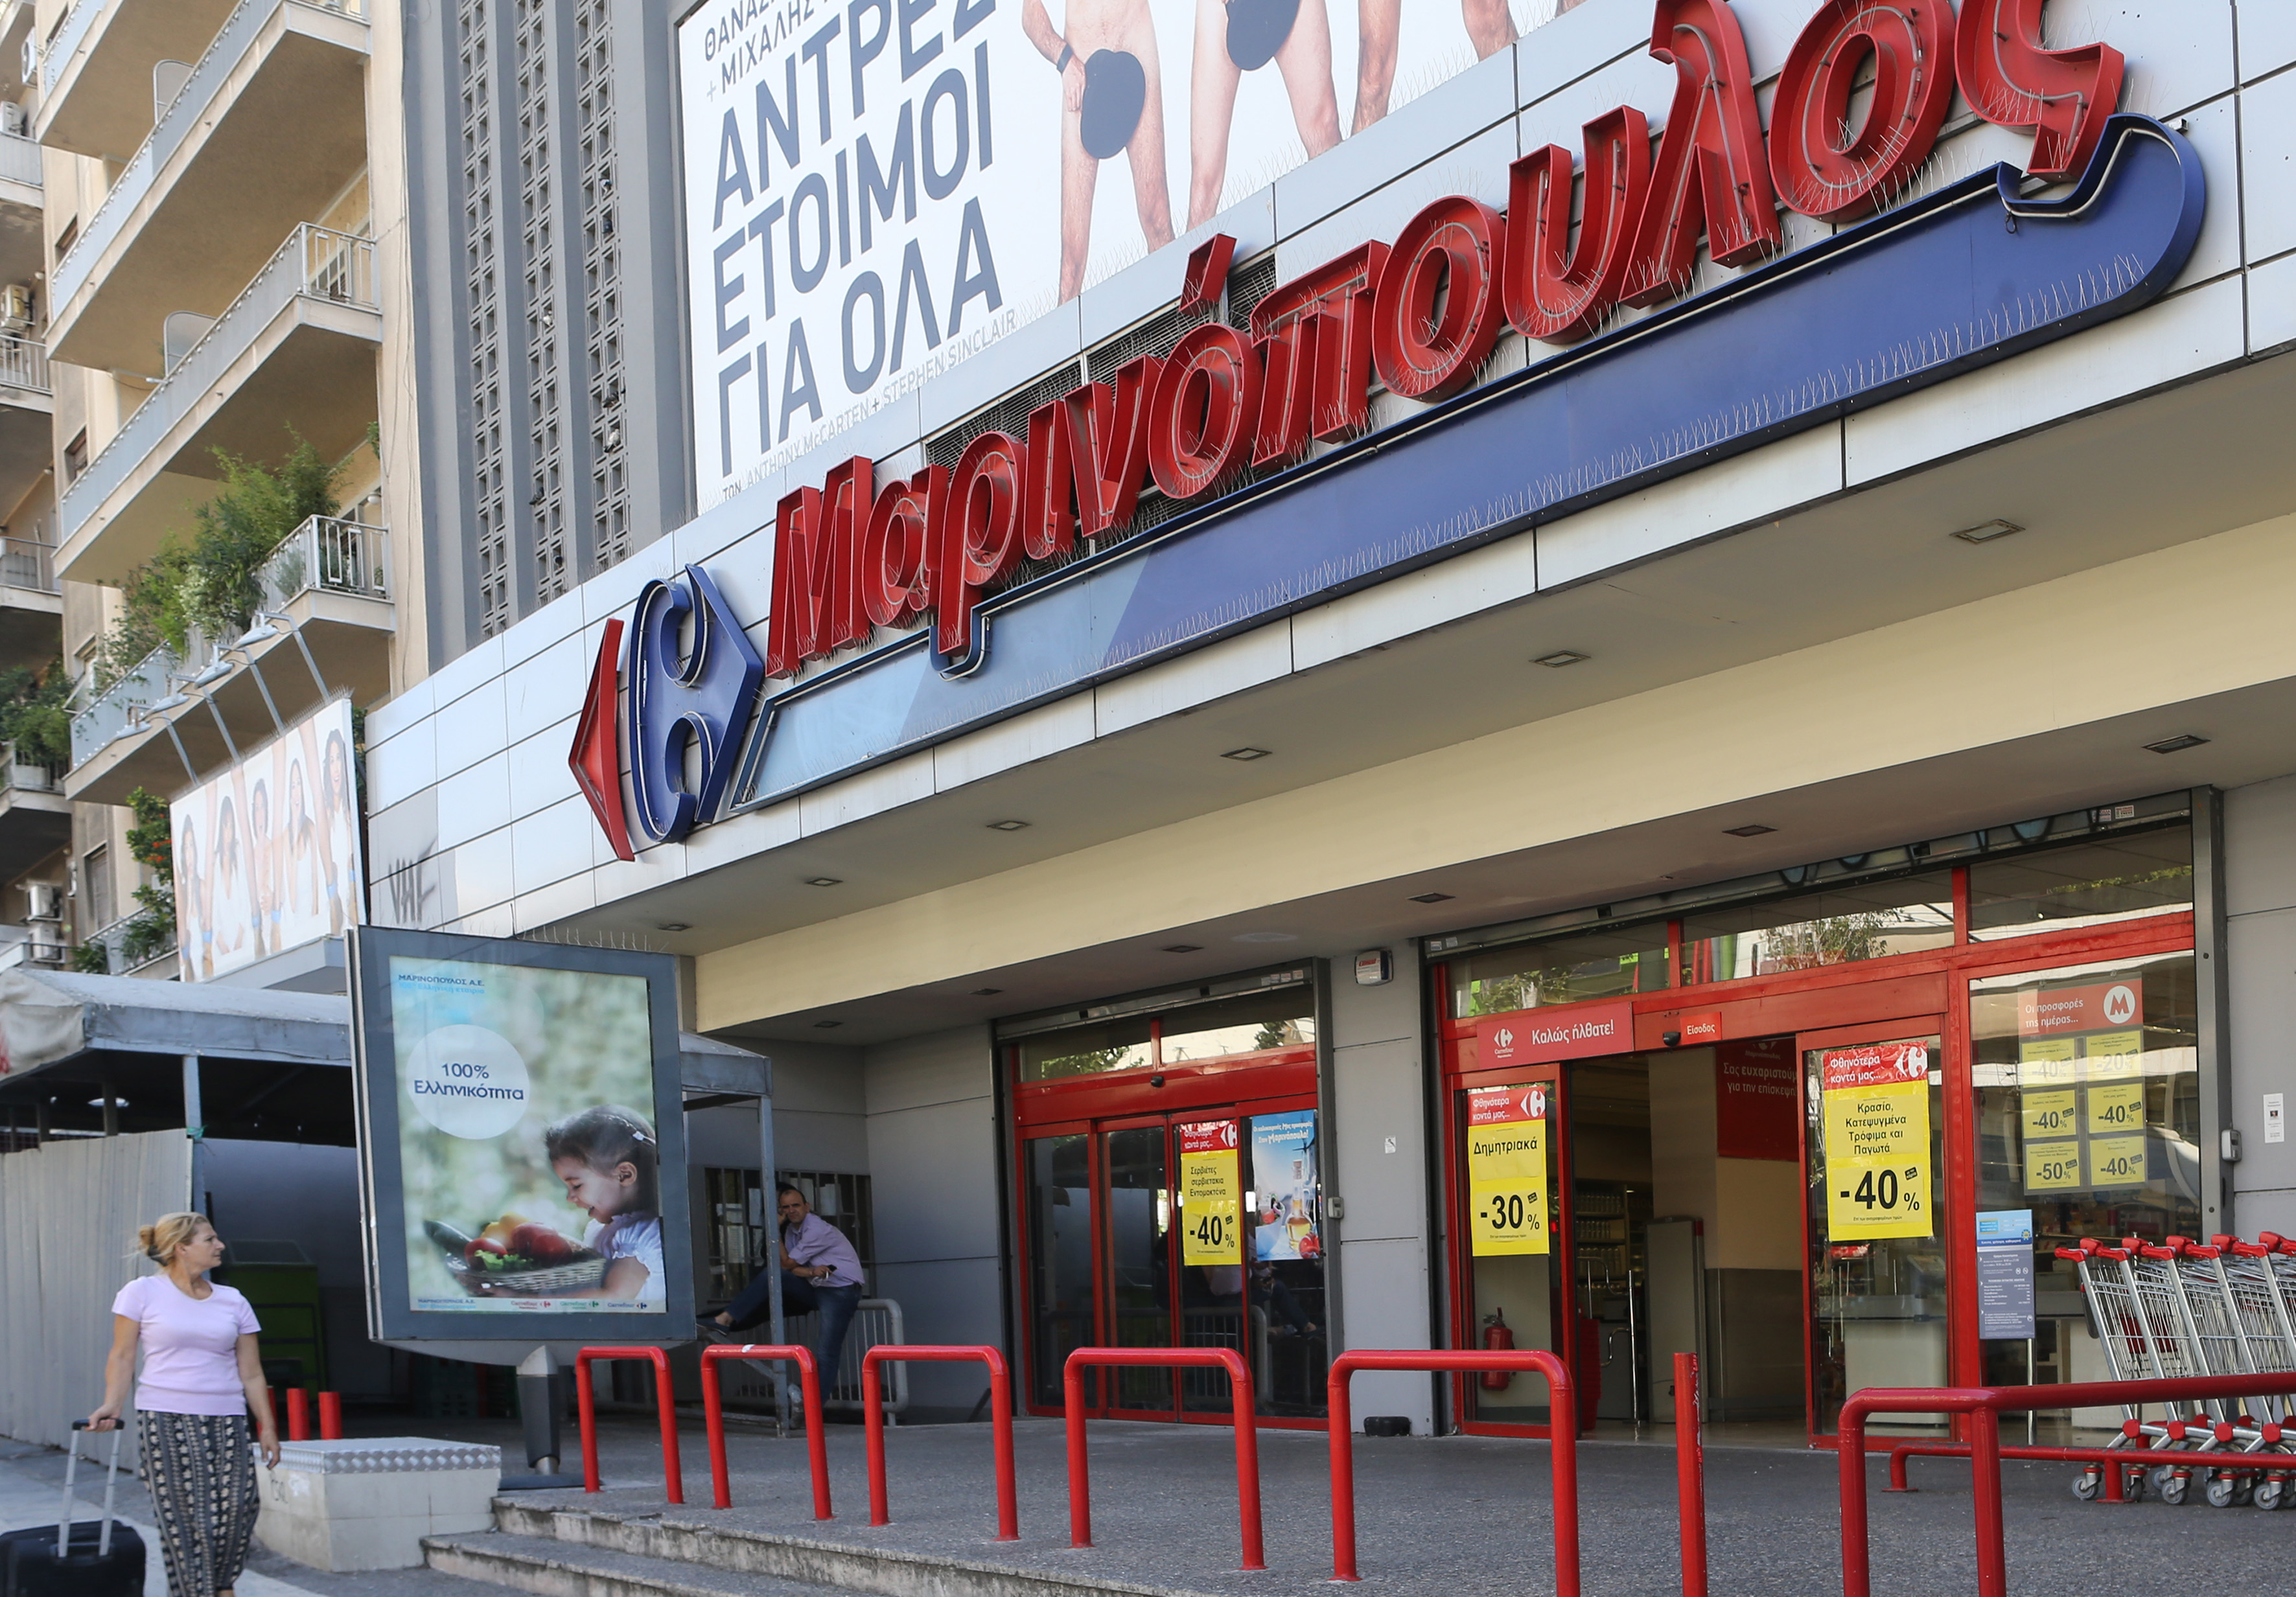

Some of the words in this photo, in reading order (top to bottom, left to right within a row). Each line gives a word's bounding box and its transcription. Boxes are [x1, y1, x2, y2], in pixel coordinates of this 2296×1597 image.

[713, 0, 996, 232] ΑΝΤΡΕ
[713, 40, 993, 355] ΕΤΟΙΜΟΙ
[719, 317, 823, 478] ΓΙΑ
[842, 196, 1003, 395] ΟΛΑ
[765, 0, 2125, 679] Μαρινόπουλος
[747, 442, 800, 488] ANTHONY
[883, 354, 944, 403] STEPHEN
[947, 308, 1016, 368] SINCLAIR
[399, 974, 467, 985] ΜΑΡΙΝΟΠΟΥΛΟΣ
[2025, 1004, 2035, 1013] Οι
[2037, 998, 2083, 1013] προσφορές
[1686, 1023, 1715, 1035] Είσοδος
[2026, 1019, 2039, 1028] της
[1532, 1026, 1570, 1045] Καλώς
[1572, 1019, 1614, 1040] ήλθατε!
[1723, 1062, 1740, 1077] Σας
[1830, 1055, 1880, 1070] Φθηνότερα
[441, 1063, 489, 1079] 100%
[1830, 1071, 1856, 1083] κοντά
[414, 1080, 524, 1100] Ελληνικότητα
[1727, 1083, 1741, 1094] για
[1743, 1083, 1756, 1093] την
[1472, 1097, 1510, 1109] Φθηνότερα
[1472, 1110, 1492, 1121] κοντά
[1846, 1114, 1907, 1129] Κατεψυγμένα
[1848, 1130, 1886, 1142] Τρόφιμα
[1890, 1130, 1903, 1138] και
[1474, 1136, 1538, 1156] Δημητριακά
[1854, 1142, 1890, 1155] Παγωτά
